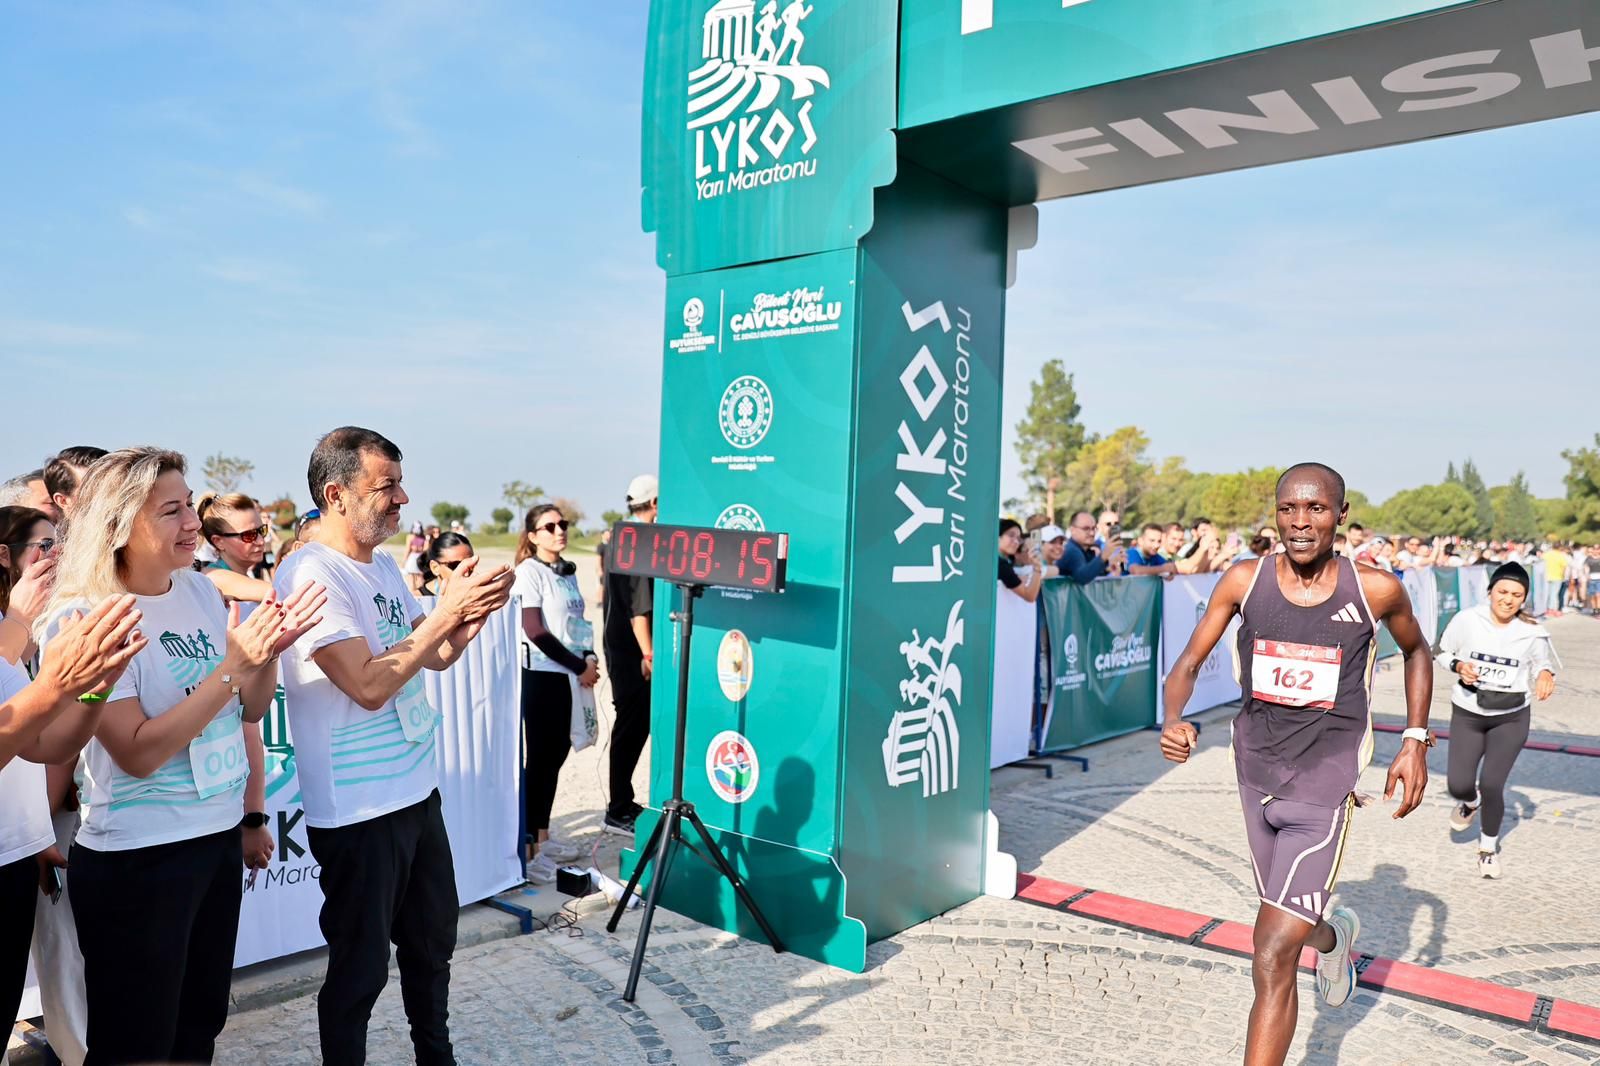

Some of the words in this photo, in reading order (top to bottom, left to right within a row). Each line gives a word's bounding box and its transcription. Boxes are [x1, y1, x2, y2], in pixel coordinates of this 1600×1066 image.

[695, 100, 817, 179] LYKOS
[696, 176, 724, 200] Yarı
[728, 158, 817, 191] Maratonu
[947, 306, 971, 502] Maratonu
[892, 301, 951, 583] LYKOS
[1272, 667, 1314, 690] 162
[1478, 666, 1507, 680] 1210
